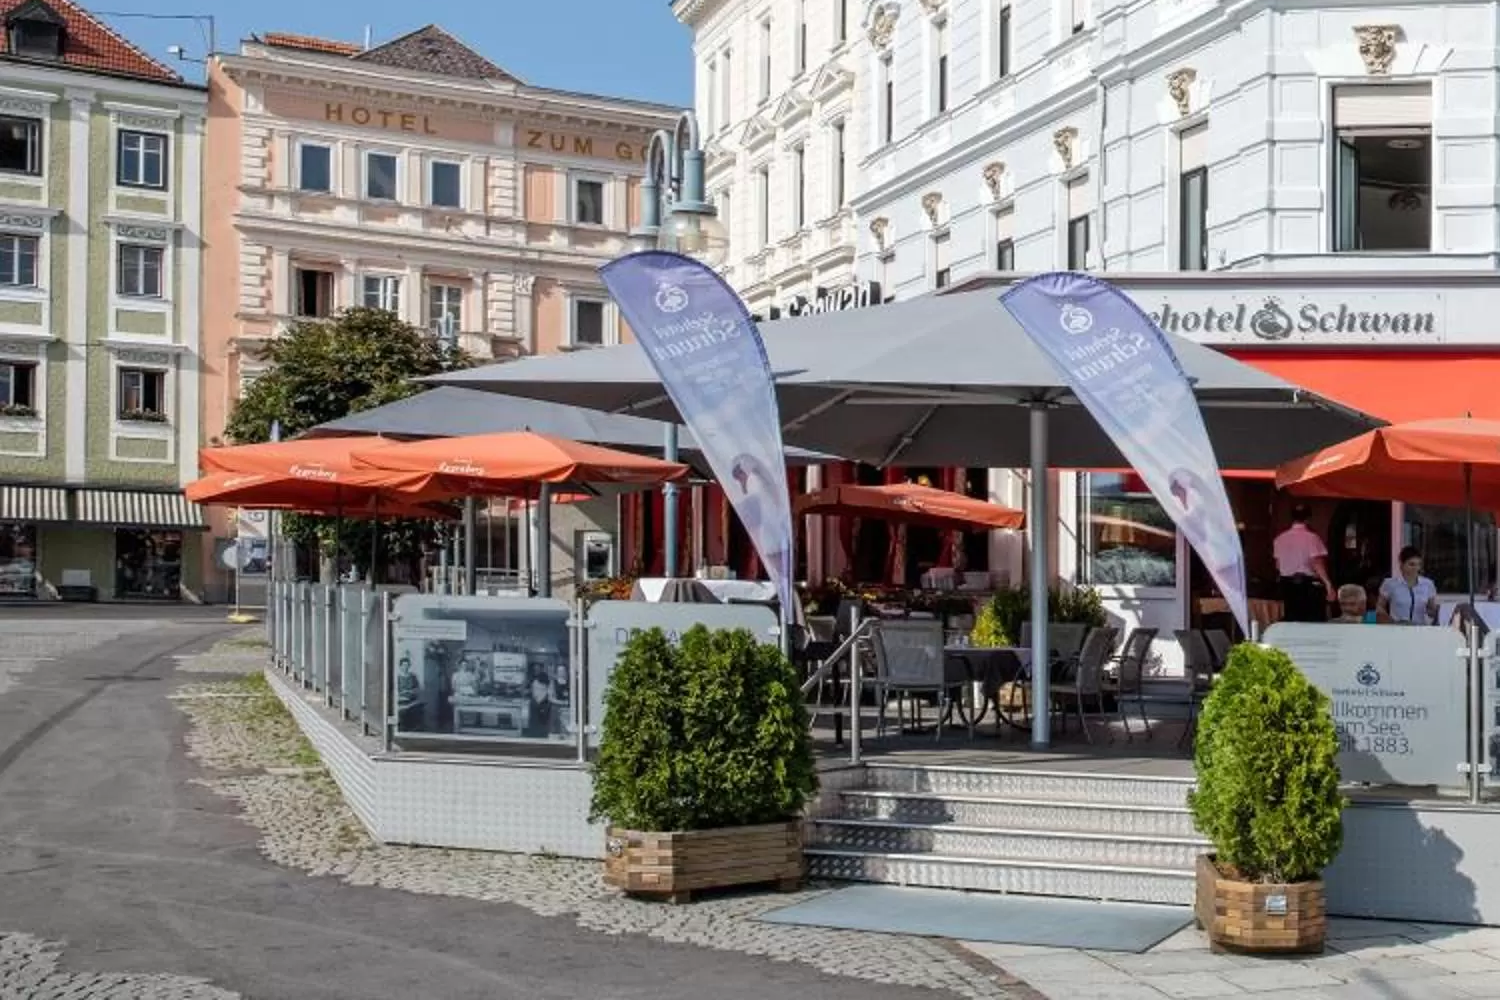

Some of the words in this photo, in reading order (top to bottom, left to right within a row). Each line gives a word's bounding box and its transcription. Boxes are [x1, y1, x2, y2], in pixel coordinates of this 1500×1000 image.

[325, 103, 439, 135] HOTEL
[527, 131, 593, 156] ZUM
[1147, 303, 1246, 333] ehotel
[1298, 303, 1435, 333] Schwan
[1331, 701, 1428, 720] illkommen
[1368, 720, 1404, 737] See.
